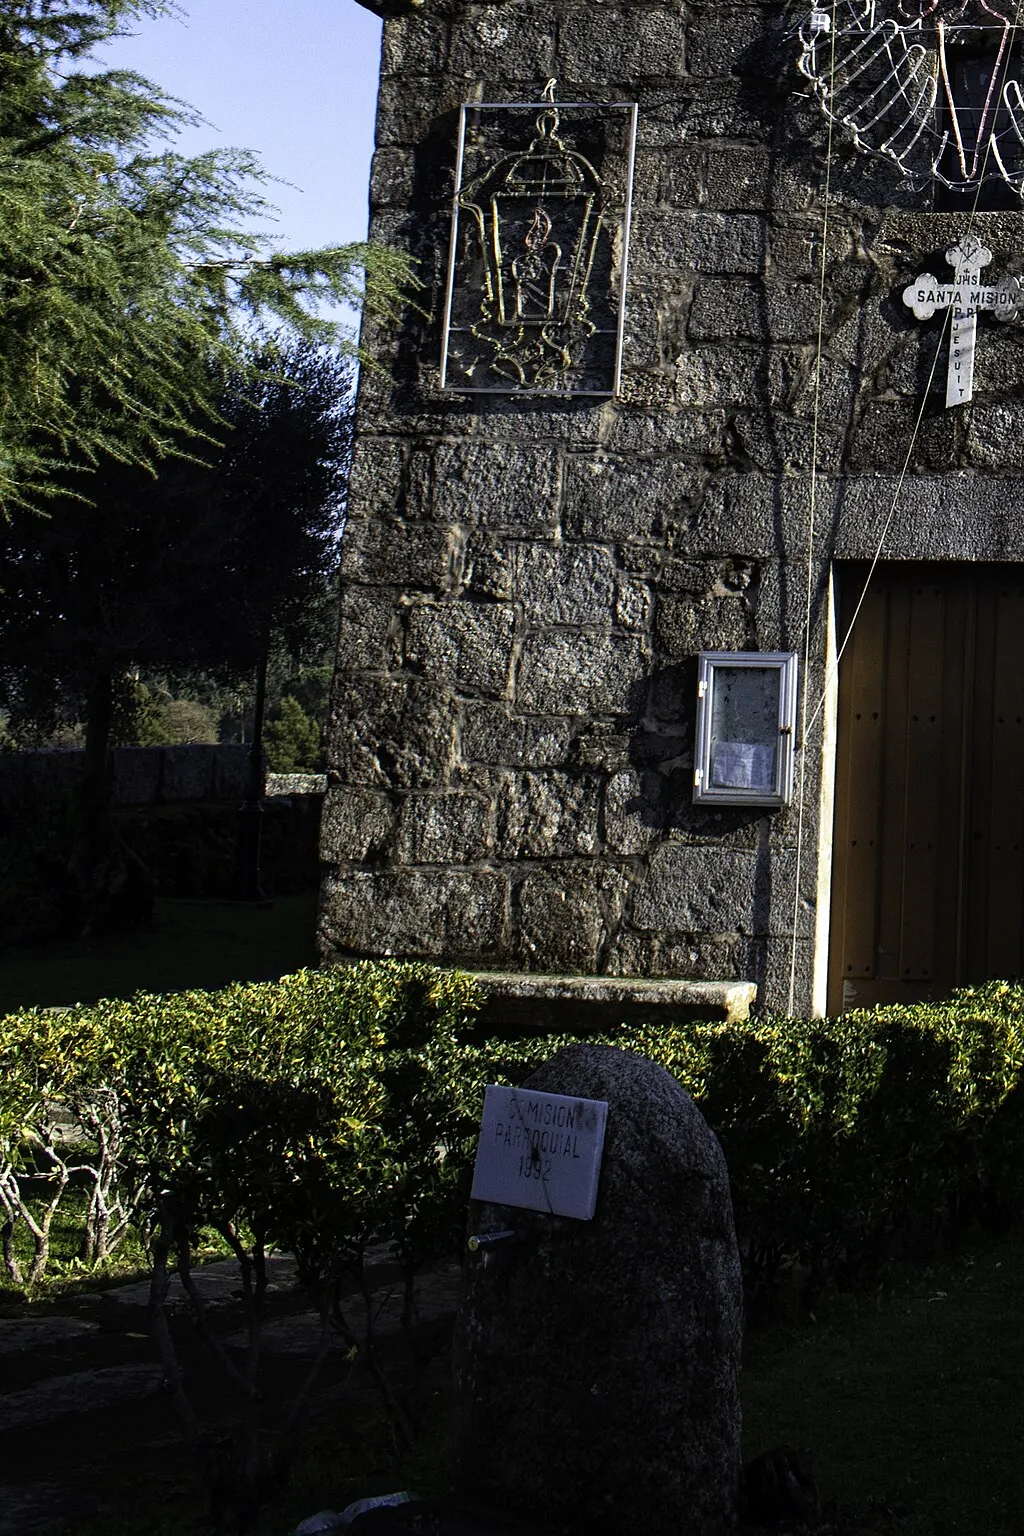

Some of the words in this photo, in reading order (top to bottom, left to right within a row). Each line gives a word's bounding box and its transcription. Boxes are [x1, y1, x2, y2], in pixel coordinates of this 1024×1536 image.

[917, 290, 962, 304] SANTA
[954, 307, 975, 319] P.P.
[519, 1155, 553, 1182] 1992
